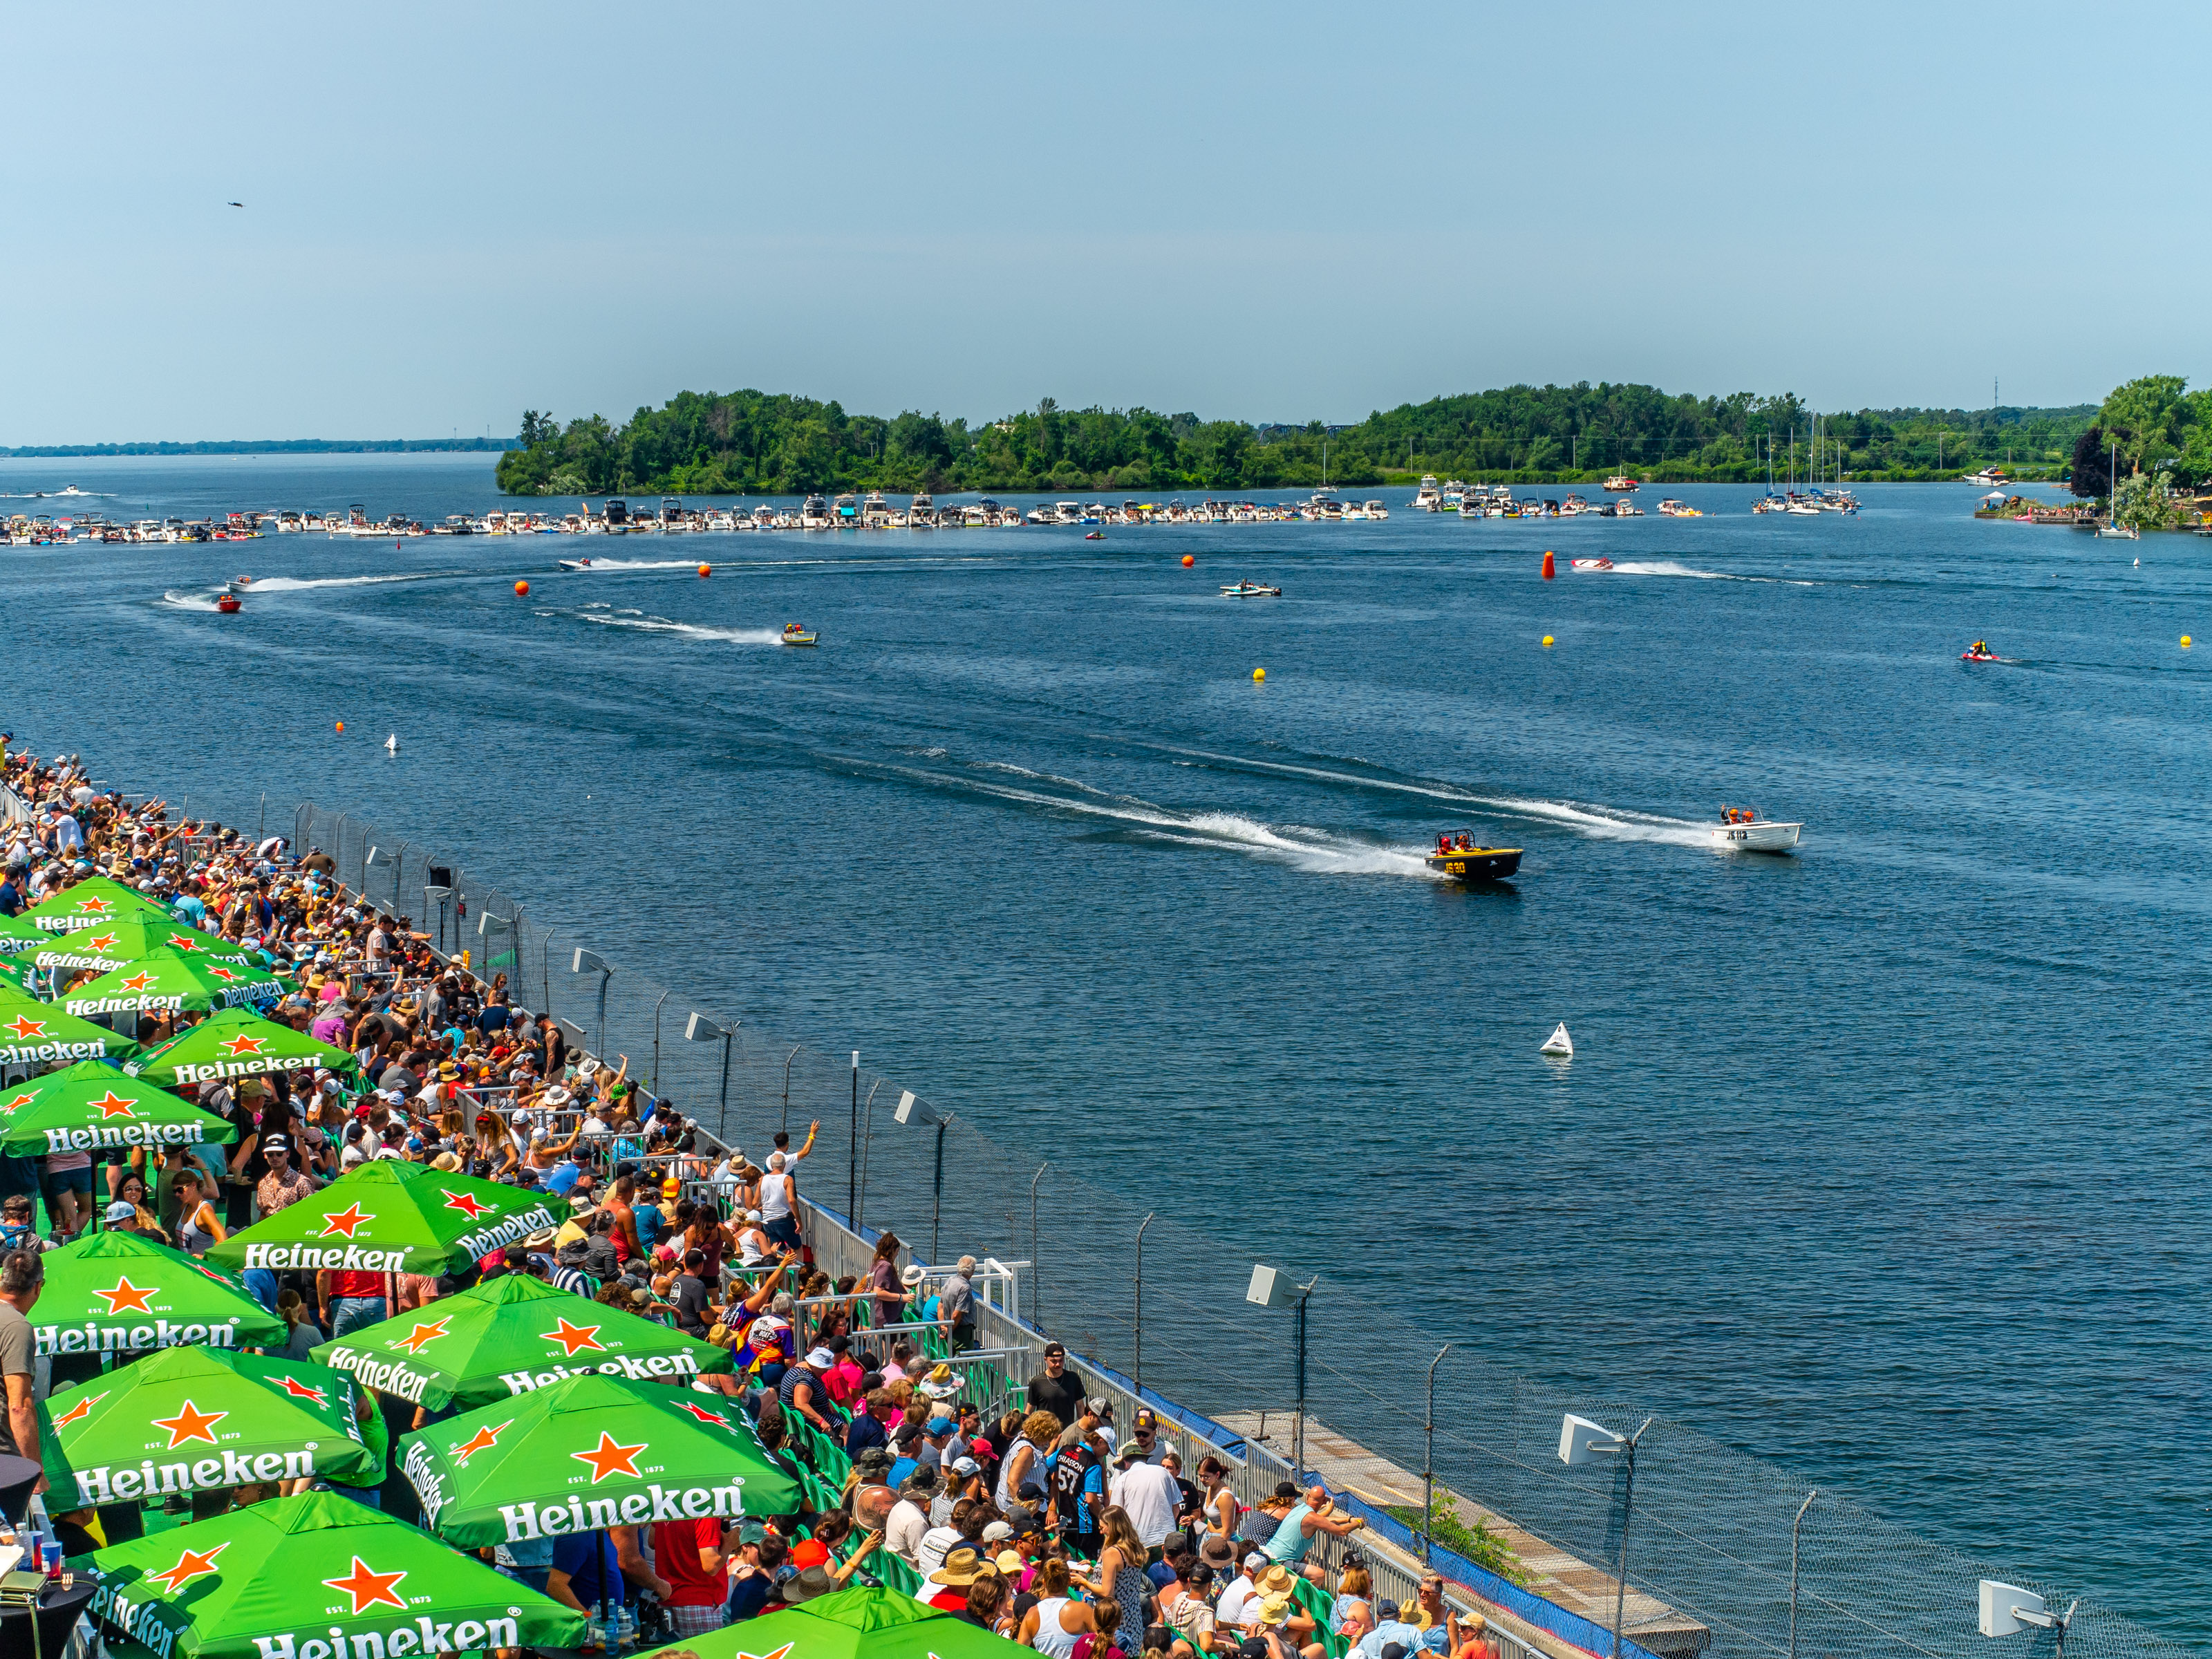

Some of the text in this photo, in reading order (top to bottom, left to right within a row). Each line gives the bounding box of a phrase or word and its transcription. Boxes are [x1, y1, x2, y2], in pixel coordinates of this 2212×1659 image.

[35, 915, 115, 930] Heine
[66, 994, 182, 1017] Heineken
[218, 980, 286, 1006] Heineken
[0, 1040, 106, 1065] eineken
[173, 1056, 321, 1085] Heineken
[43, 1121, 205, 1153] Heineken
[456, 1207, 556, 1264] Heineken
[243, 1243, 405, 1273] Heineken
[34, 1320, 236, 1358] Heineken
[144, 1441, 164, 1450] EST.
[1058, 1454, 1085, 1473] CHIASSON
[73, 1450, 316, 1507] Heineken
[568, 1476, 588, 1484] EST.
[1058, 1464, 1079, 1494] 57
[498, 1484, 746, 1543] Heineken
[927, 1539, 948, 1551] BILLABON
[86, 1567, 173, 1659] eineken
[326, 1595, 432, 1615] EST. 1873
[252, 1616, 521, 1659] Heineken
